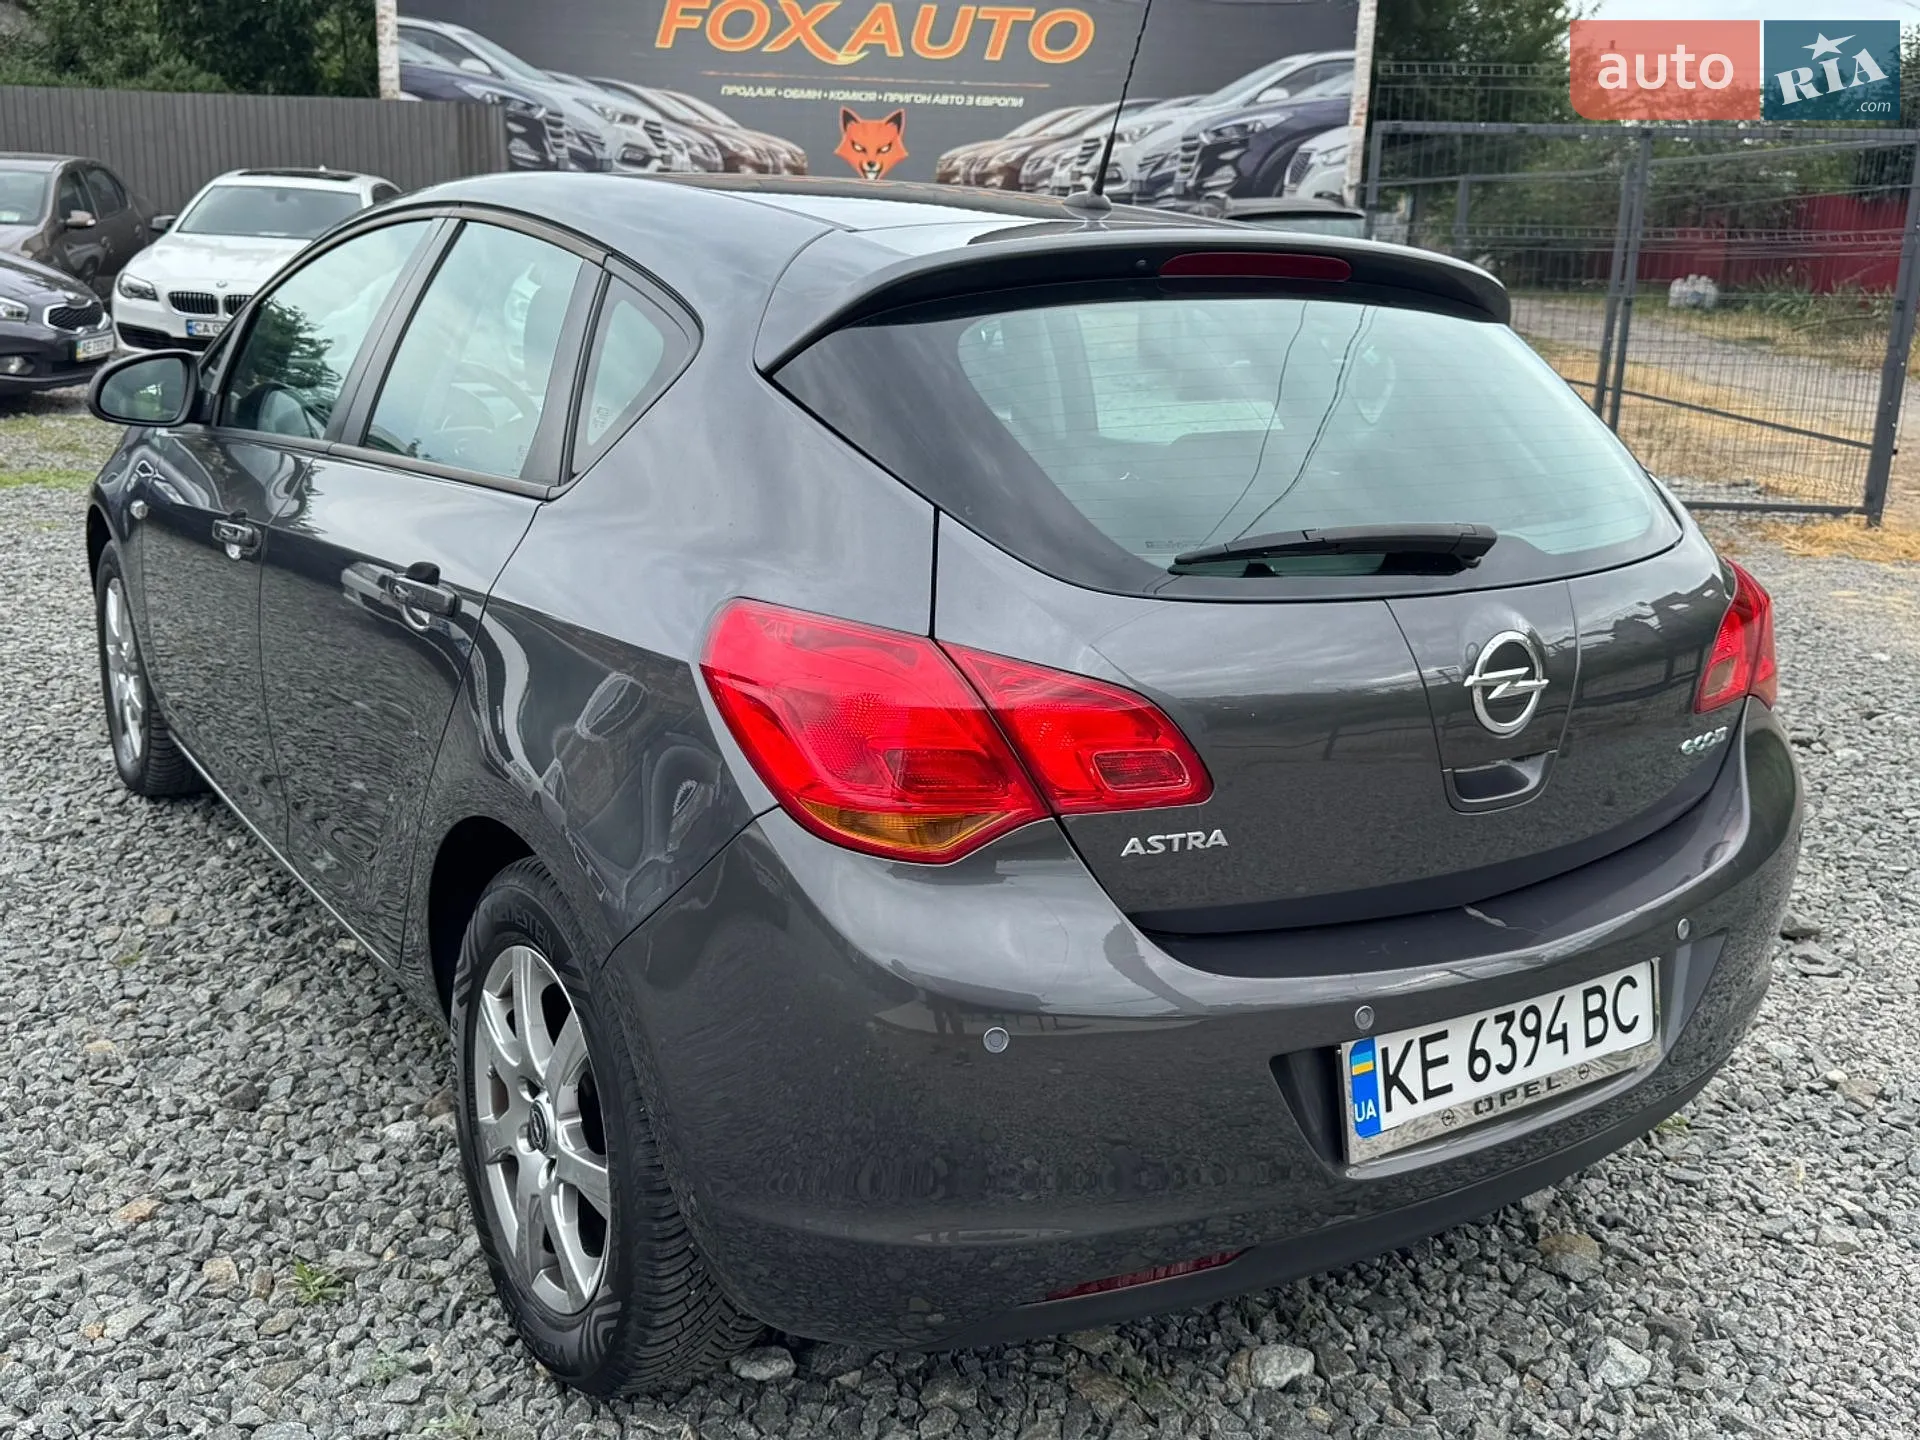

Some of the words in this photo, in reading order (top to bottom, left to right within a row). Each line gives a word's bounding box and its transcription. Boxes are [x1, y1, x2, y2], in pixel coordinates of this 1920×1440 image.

[654, 0, 1096, 65] FOXAUTO
[720, 85, 777, 97] ПРОДАЖ
[883, 92, 930, 105] ПРИГОН
[932, 94, 963, 106] АВТО
[975, 97, 1024, 108] ЄВРОПИ
[1120, 829, 1228, 857] ASTRA
[1381, 1029, 1453, 1112] KE
[1468, 994, 1568, 1083] 6394
[1582, 975, 1639, 1048] BC
[1354, 1098, 1378, 1122] UA
[1473, 1076, 1562, 1115] OPEL
